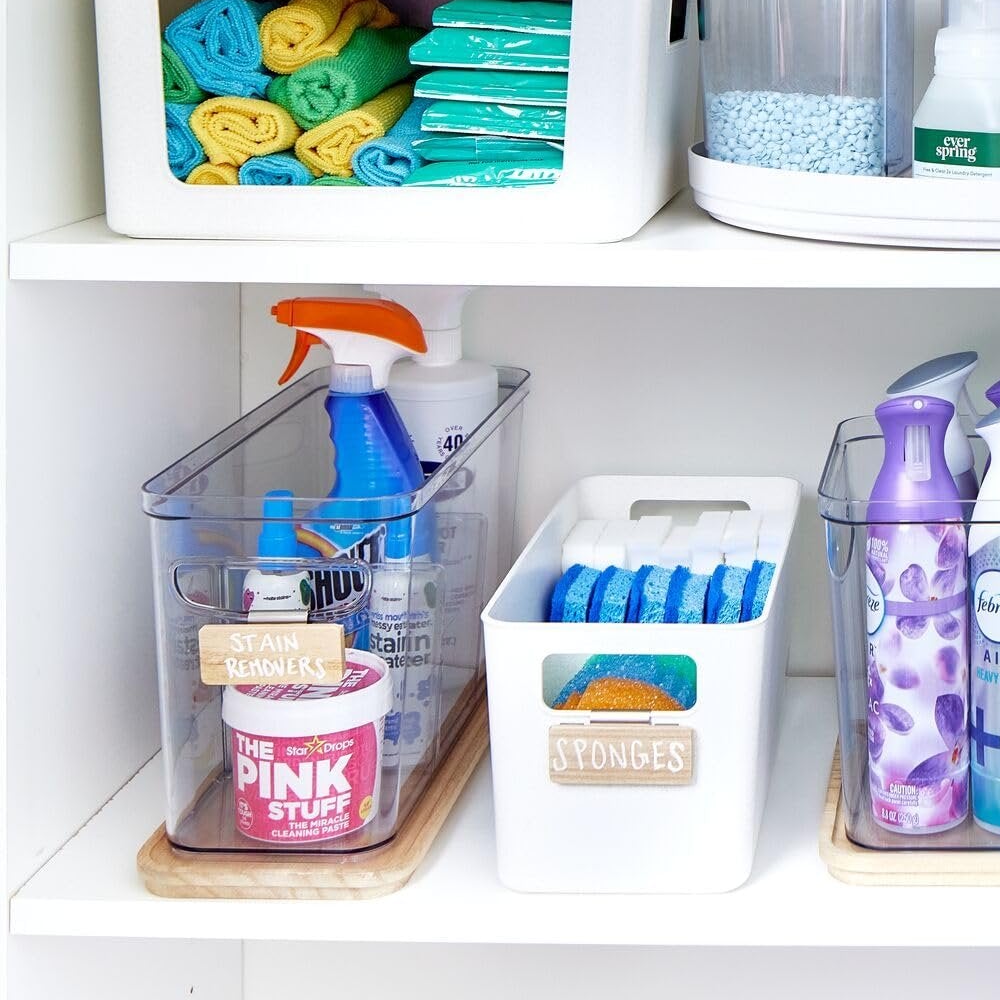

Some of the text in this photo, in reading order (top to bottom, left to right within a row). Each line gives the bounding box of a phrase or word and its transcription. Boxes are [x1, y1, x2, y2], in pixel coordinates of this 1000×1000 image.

[943, 136, 970, 148] ever
[936, 146, 977, 162] spring
[443, 434, 464, 452] 40
[229, 632, 299, 653] STAIN
[224, 656, 326, 680] REMOVERS
[977, 666, 999, 684] HEAVY
[236, 732, 355, 760] THE Star Drops
[552, 738, 685, 773] SPONGES
[236, 753, 352, 801] PINK
[268, 793, 352, 821] STUFF
[271, 821, 350, 839] CLEANING PASTE
[289, 813, 350, 830] THE MIRACLE
